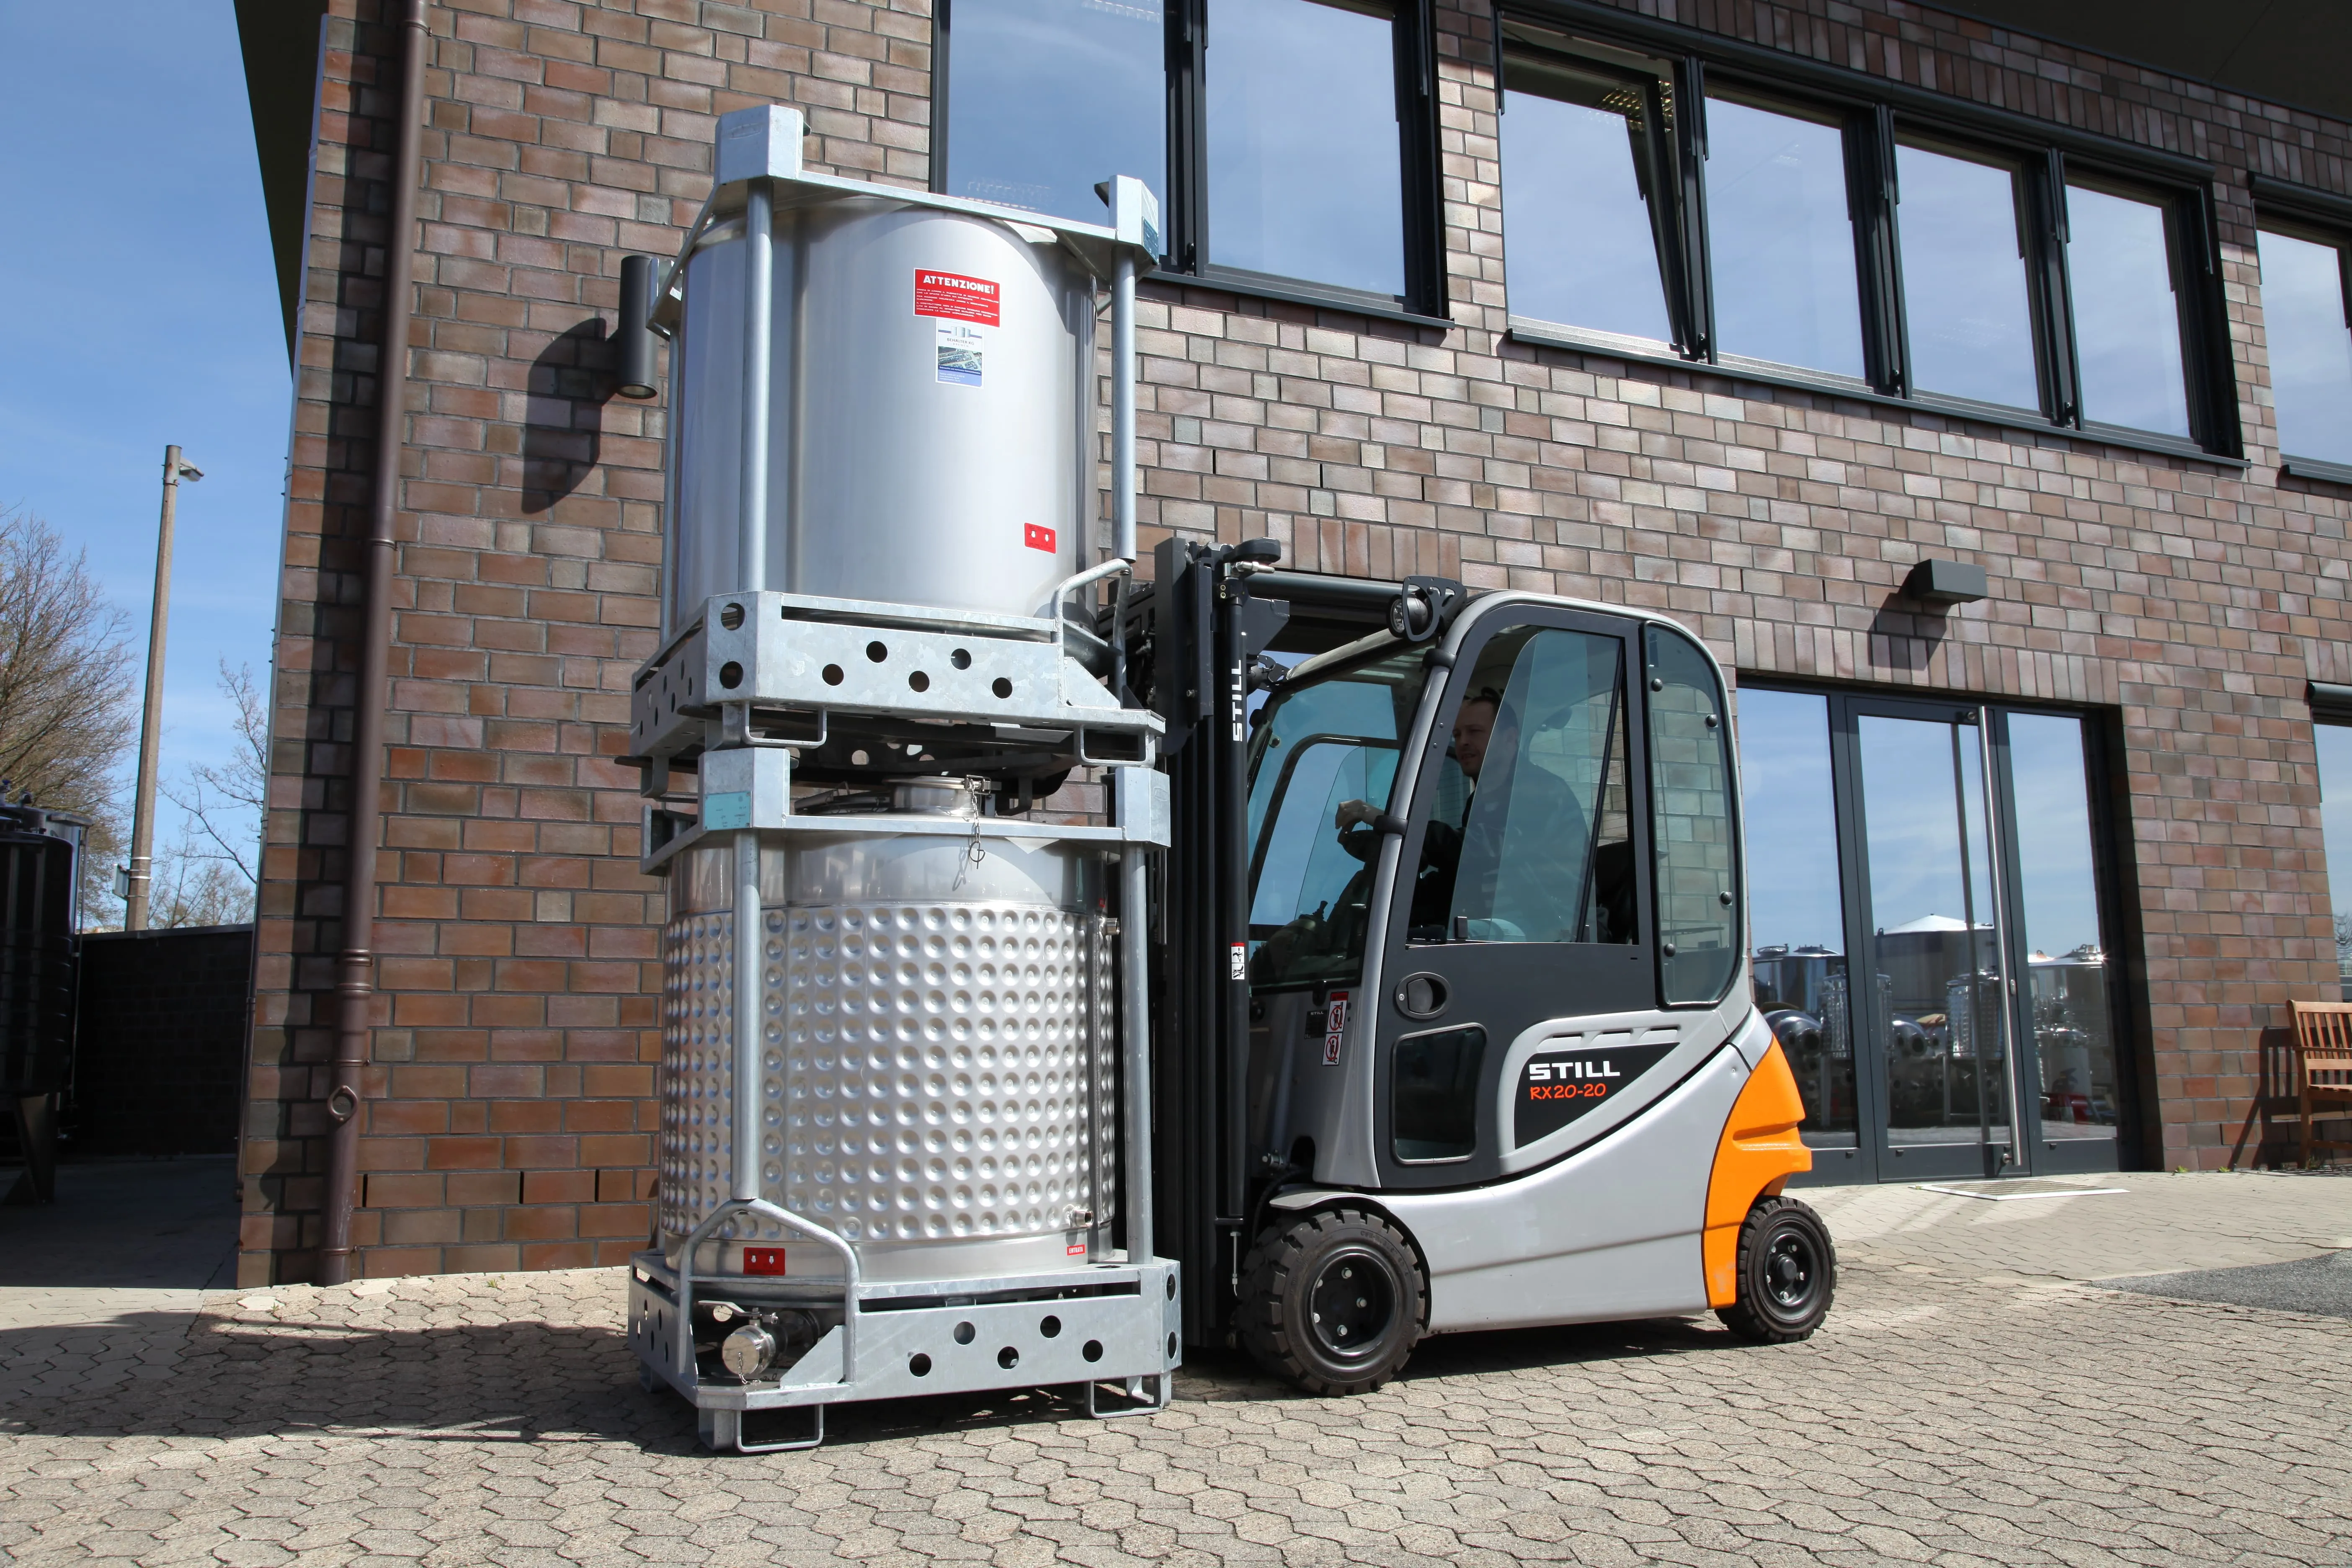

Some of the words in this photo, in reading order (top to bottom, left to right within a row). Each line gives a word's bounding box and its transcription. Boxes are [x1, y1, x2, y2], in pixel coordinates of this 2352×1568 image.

[923, 275, 994, 294] ATTENZIONE!
[1232, 660, 1243, 742] STILL
[1529, 1060, 1620, 1081] STILL
